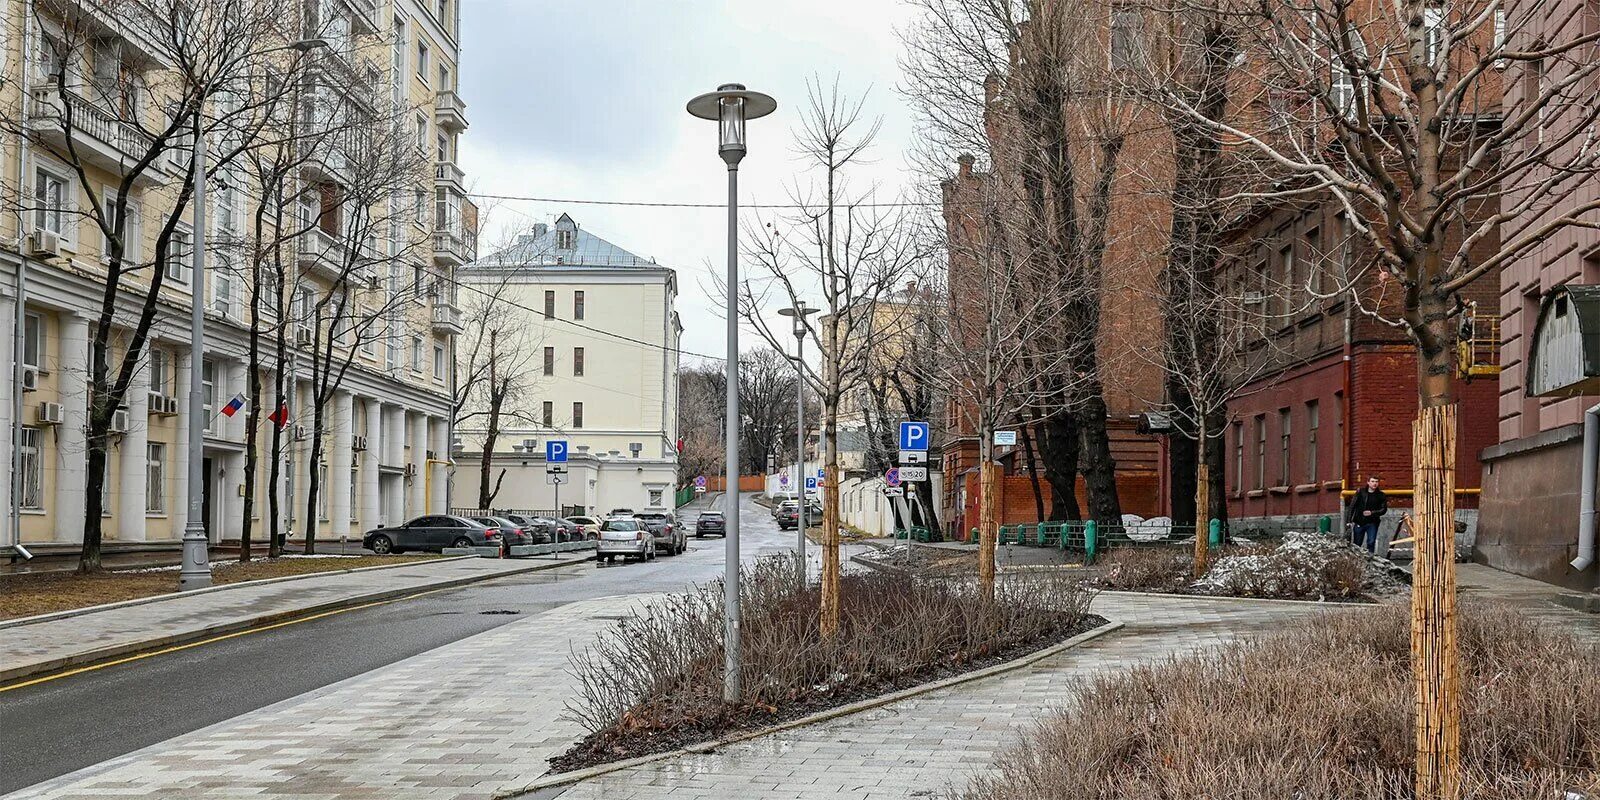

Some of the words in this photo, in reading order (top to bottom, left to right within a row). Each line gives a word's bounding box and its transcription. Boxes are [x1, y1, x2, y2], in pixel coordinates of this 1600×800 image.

[908, 425, 923, 447] P
[552, 443, 563, 460] P
[915, 470, 924, 478] 20
[808, 478, 814, 487] P
